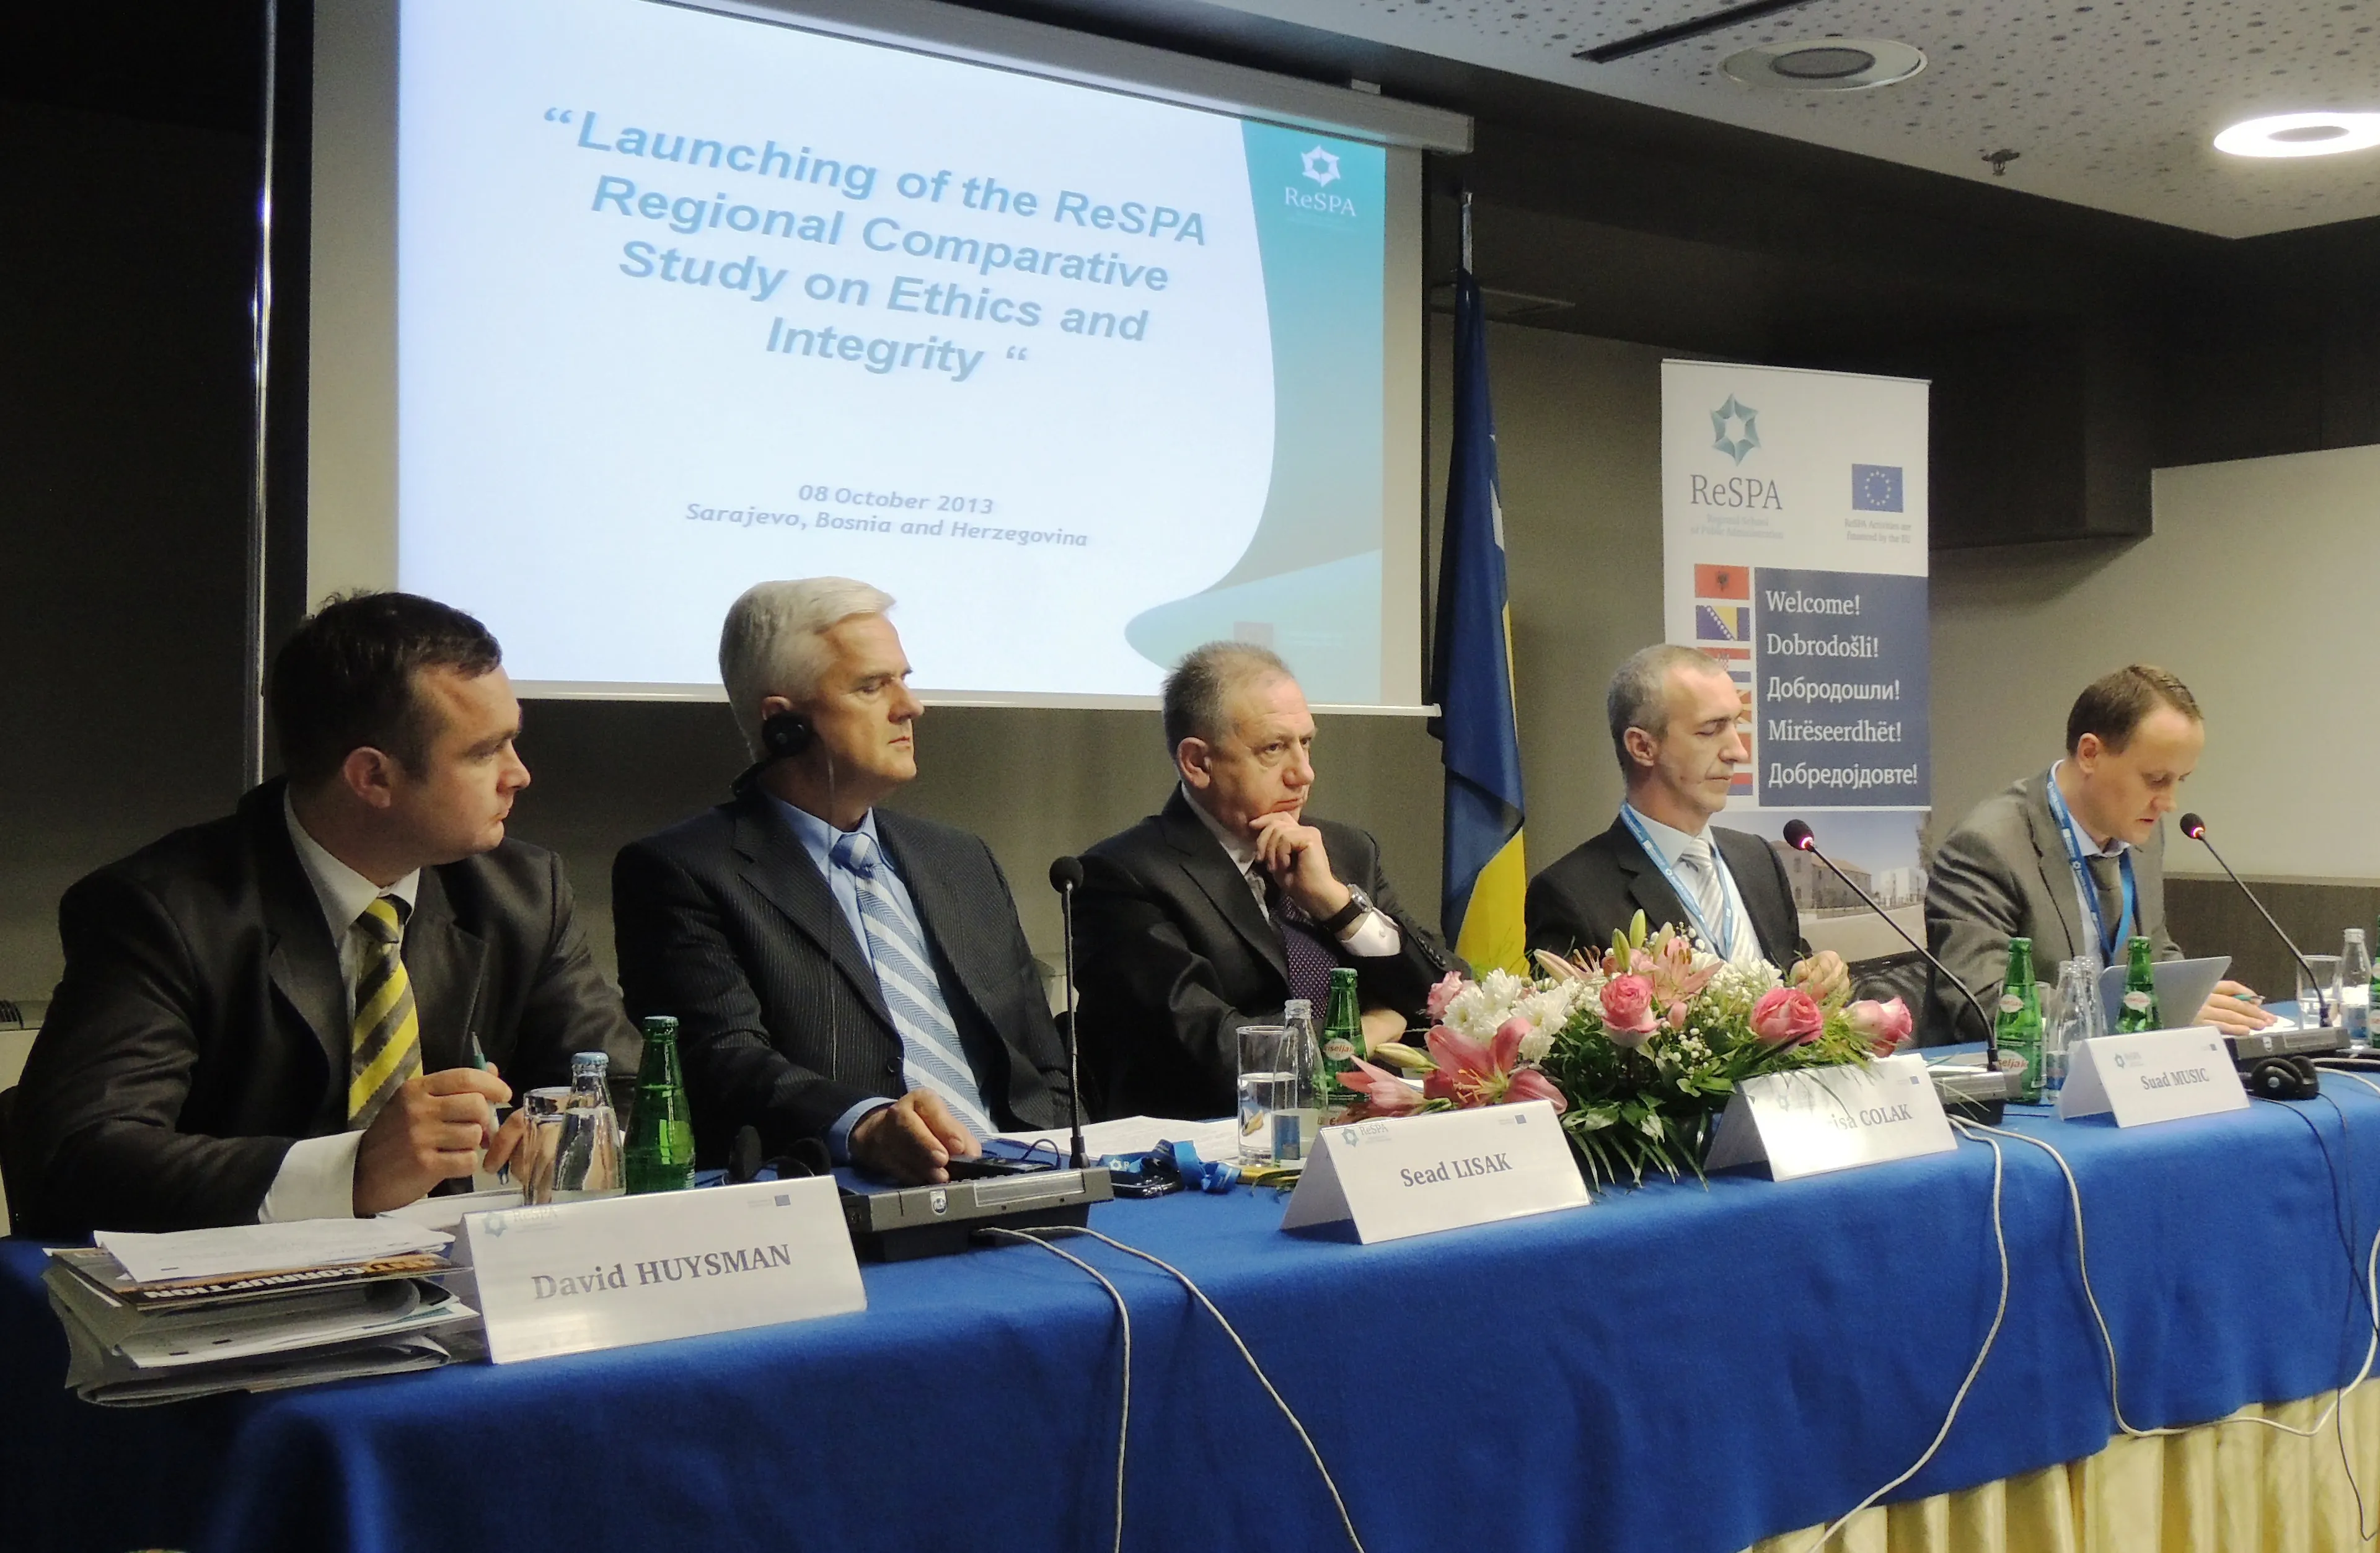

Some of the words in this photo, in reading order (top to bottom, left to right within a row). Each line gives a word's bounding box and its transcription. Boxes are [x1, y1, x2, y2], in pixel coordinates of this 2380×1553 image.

[896, 169, 952, 203] of
[961, 177, 1038, 218] the
[1054, 189, 1205, 247] ReSPA
[1284, 186, 1357, 217] ReSPA
[591, 174, 845, 245] Regional
[862, 216, 1170, 292] Comparative
[619, 239, 790, 302] Study
[804, 273, 870, 307] on
[886, 275, 1042, 327] Ethics
[1059, 307, 1150, 341] and
[765, 315, 985, 382] Integrity
[798, 484, 829, 502] 08
[835, 487, 931, 509] October
[937, 495, 994, 514] 2013
[1690, 474, 1783, 511] ReSPA
[685, 503, 808, 531] Sarajevo,
[814, 511, 891, 533] Bosnia
[899, 519, 944, 536] and
[950, 521, 1088, 547] Herzegovina
[1765, 590, 1861, 615] Welcome!
[1766, 633, 1879, 658] Dobrodošli!
[1767, 676, 1900, 703] Добродошли!
[1768, 719, 1902, 742] Mirëseerdhët!
[1768, 761, 1918, 790] Добредојдовте!
[2140, 1071, 2171, 1090] Suad
[2170, 1067, 2210, 1086] MUSIC
[1860, 1103, 1913, 1127] COLAK
[1399, 1160, 1452, 1187] Sead
[1450, 1152, 1514, 1179] LISAK
[531, 1262, 629, 1300] David
[634, 1243, 792, 1286] HUYSMAN
